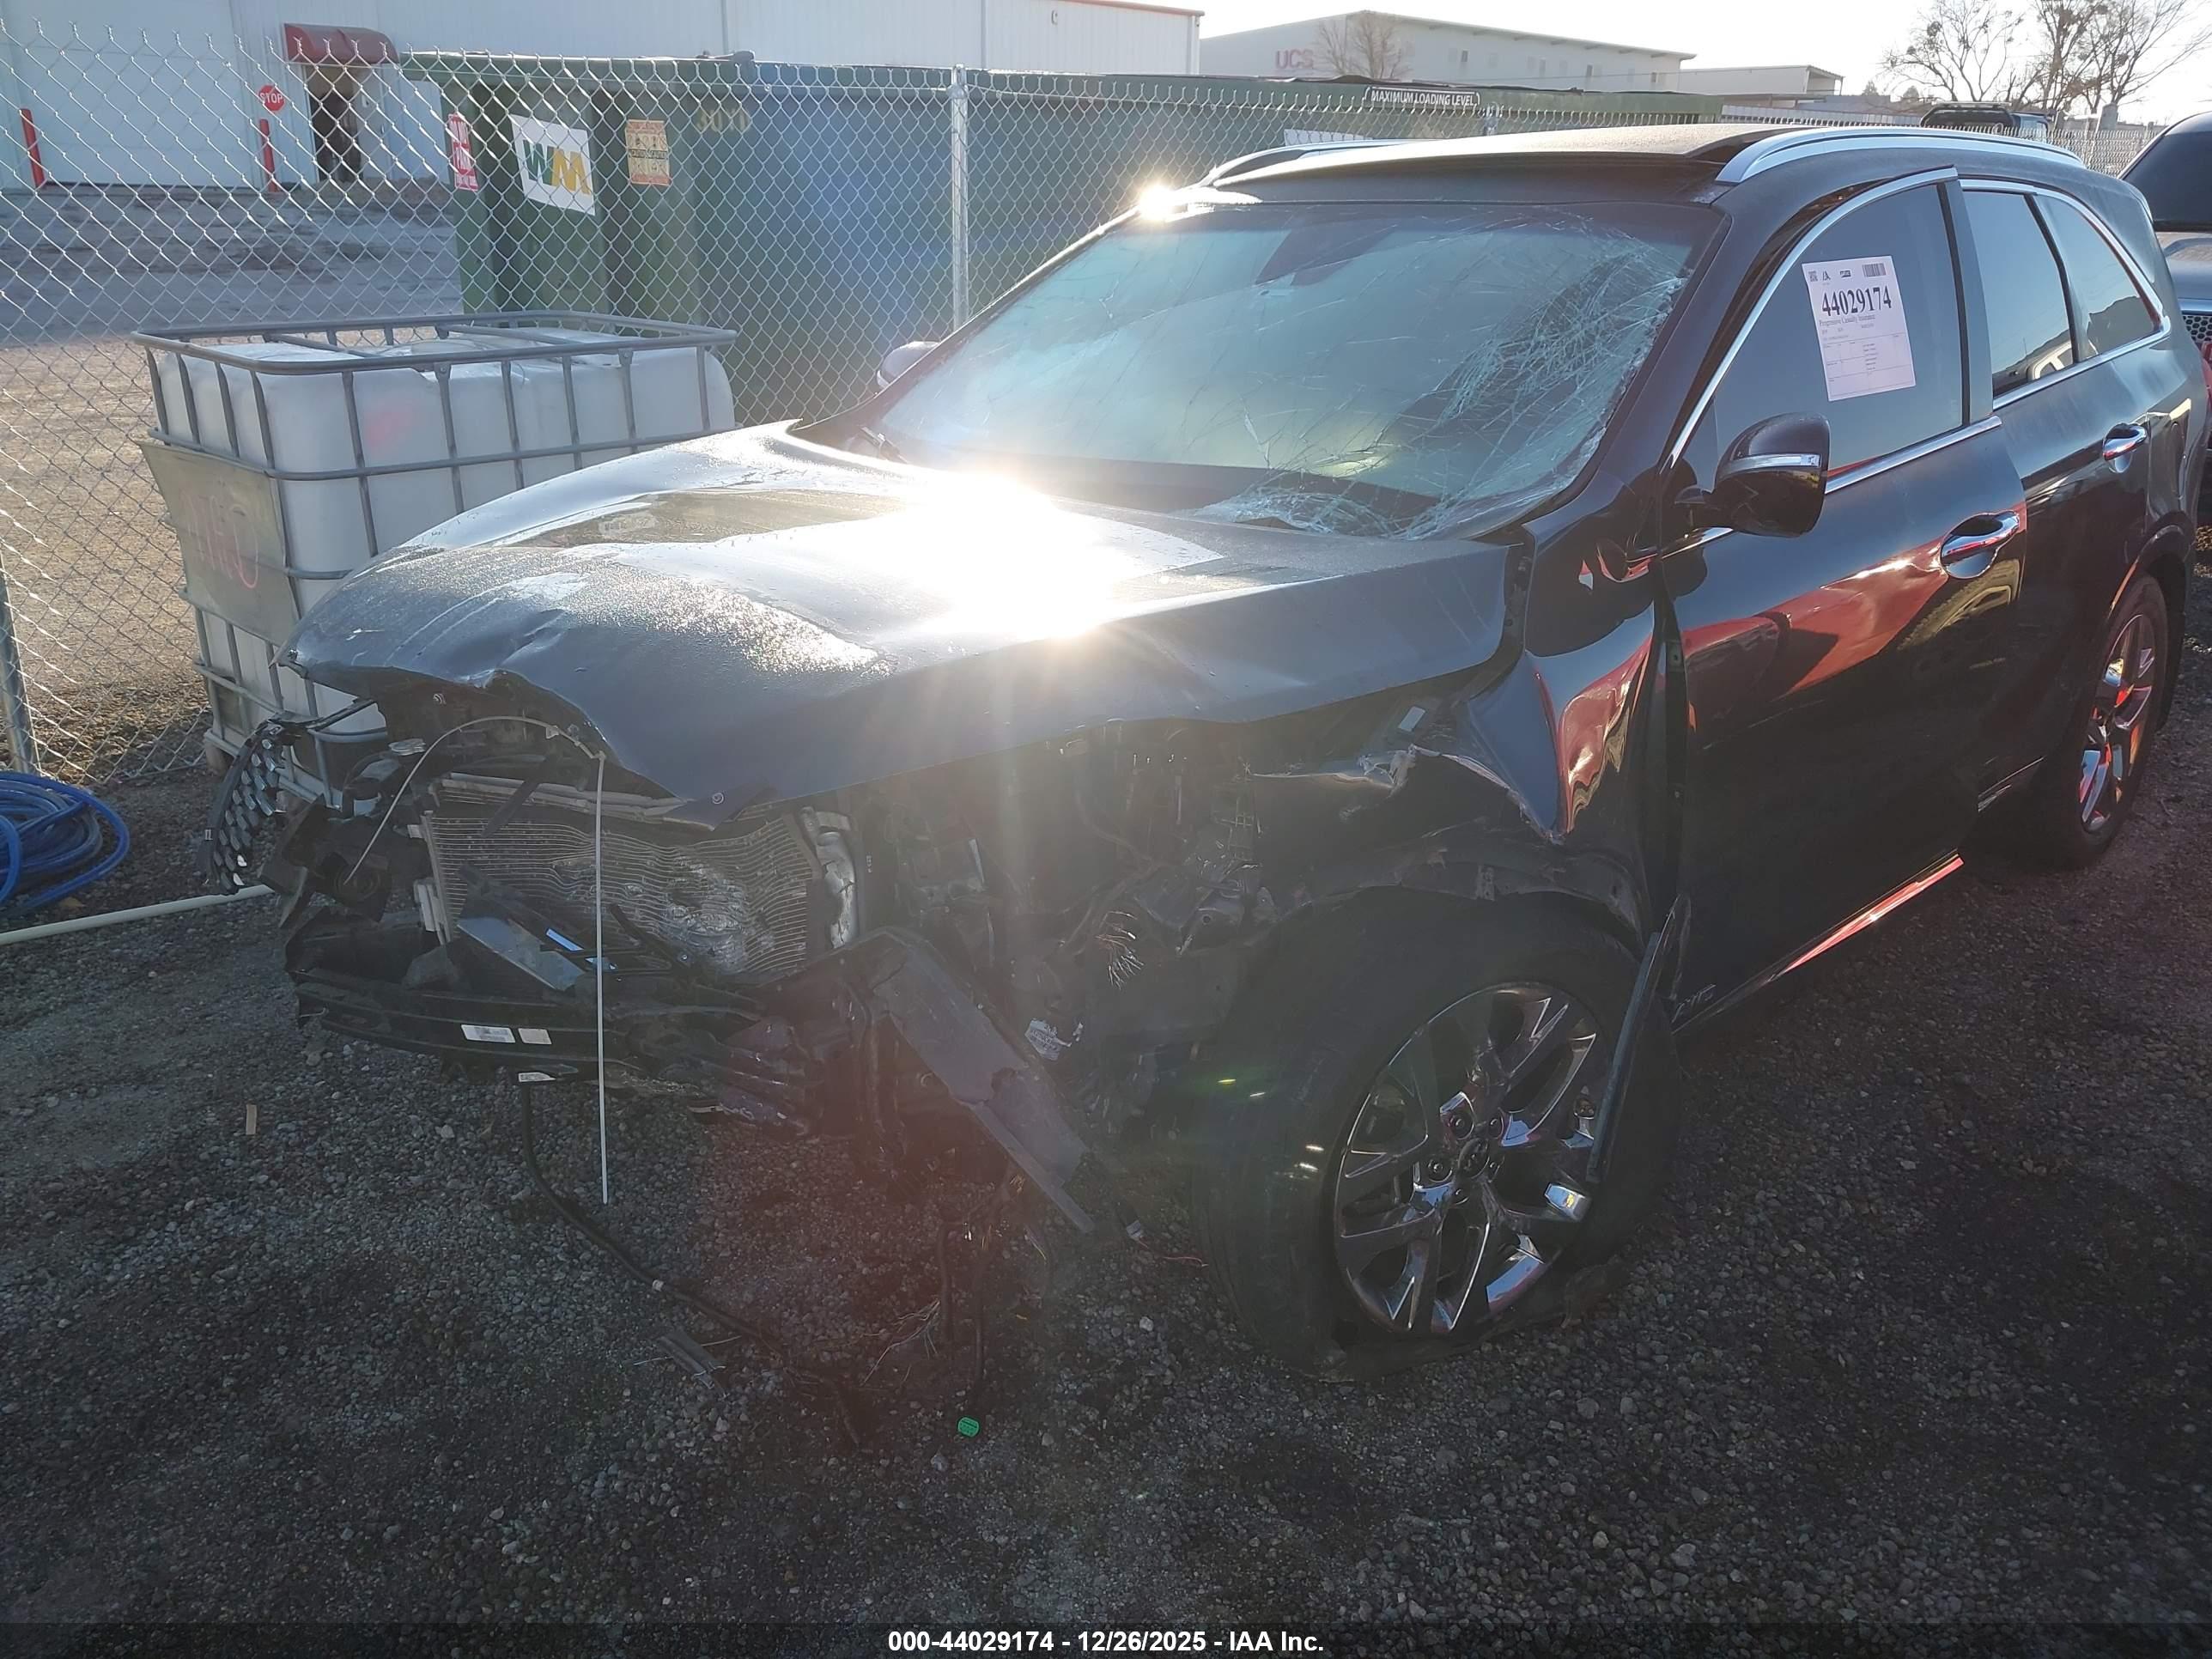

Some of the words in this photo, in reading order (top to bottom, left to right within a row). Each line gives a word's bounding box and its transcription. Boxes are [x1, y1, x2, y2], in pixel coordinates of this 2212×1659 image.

[1275, 49, 1314, 69] UCS
[259, 92, 283, 104] STOP
[1371, 90, 1413, 103] MAXIMUM
[1414, 94, 1450, 105] LOADING
[1451, 94, 1475, 106] LEVEL
[523, 139, 592, 195] WM
[1821, 285, 1892, 317] 44029174
